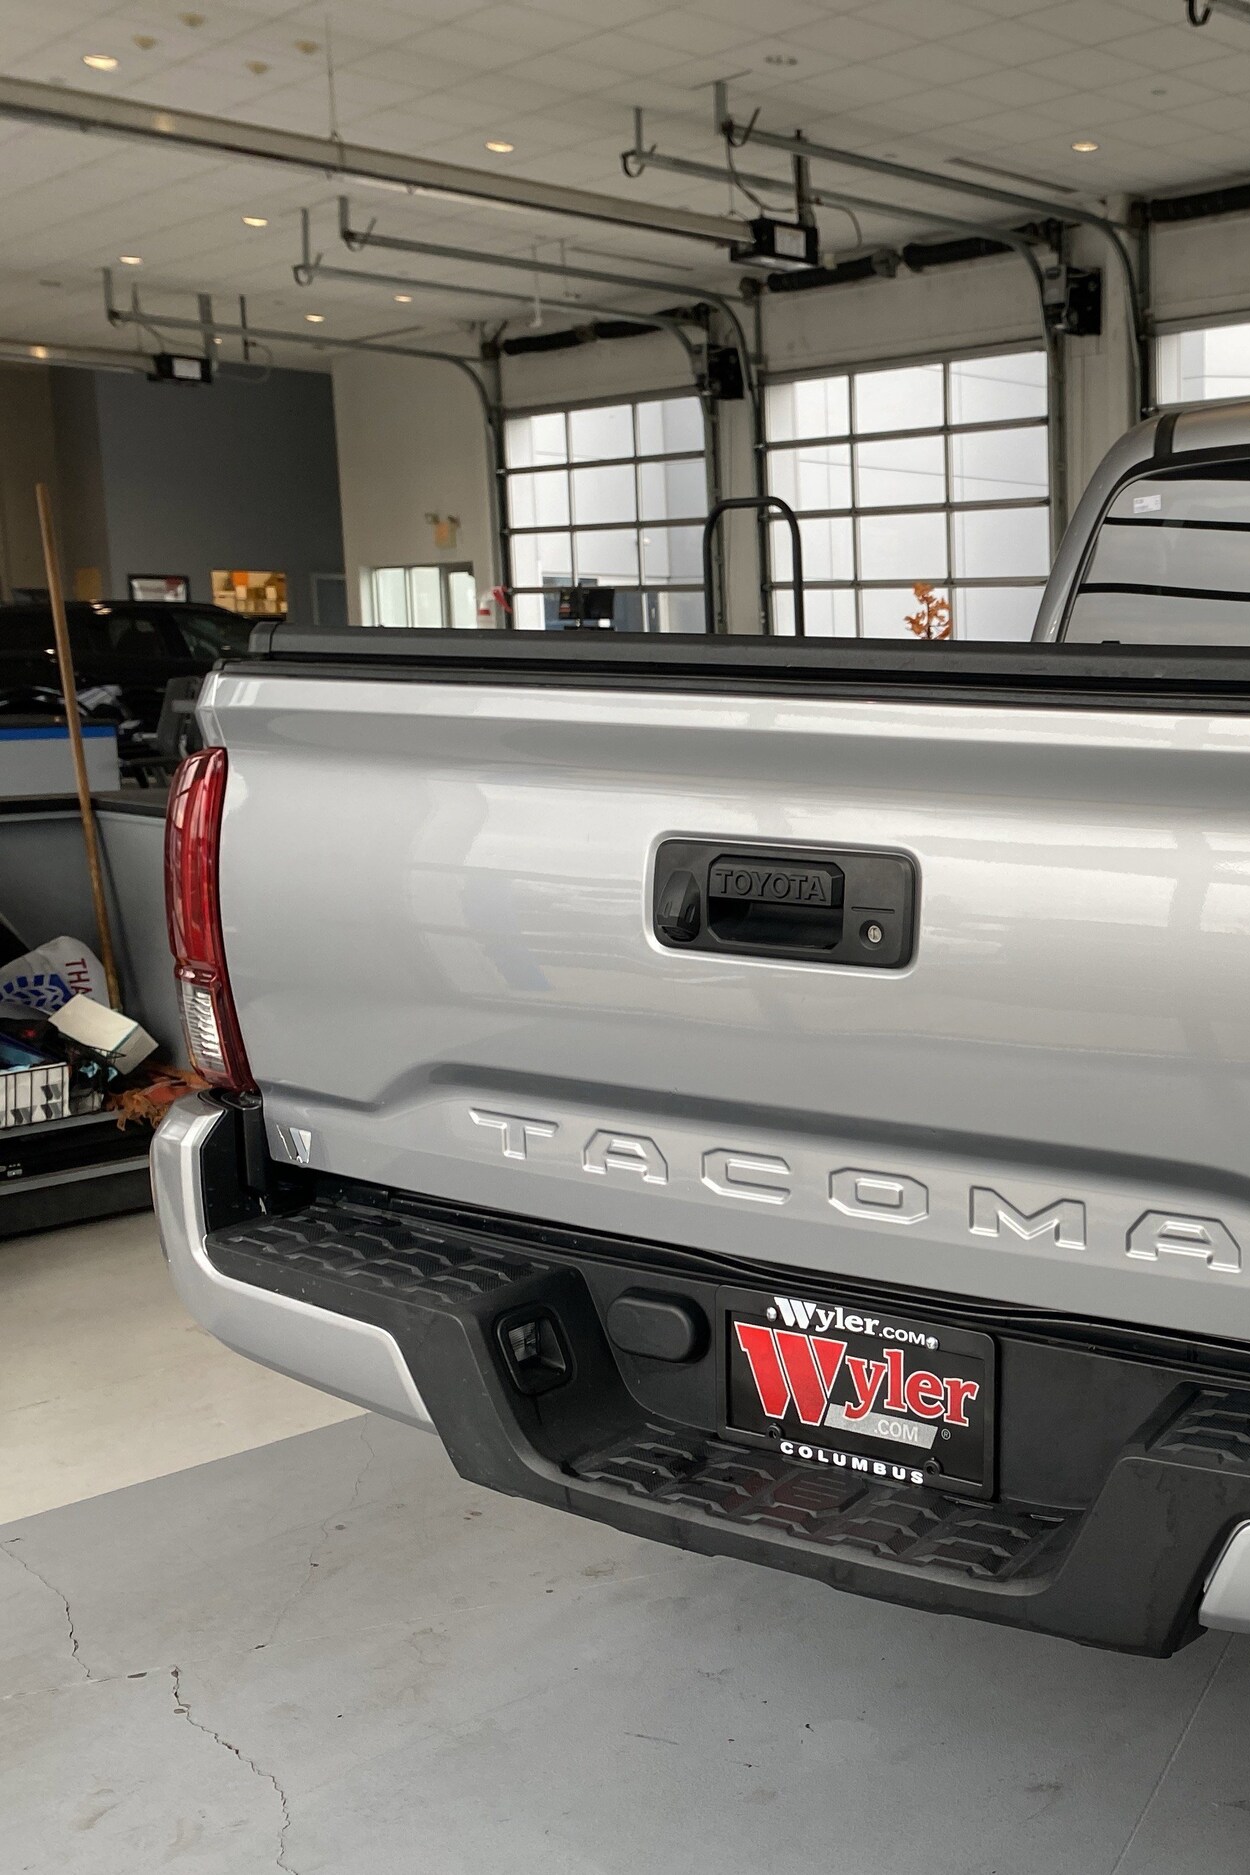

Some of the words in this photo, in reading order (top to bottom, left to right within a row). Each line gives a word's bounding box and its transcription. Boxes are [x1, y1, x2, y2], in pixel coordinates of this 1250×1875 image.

[715, 869, 827, 901] TOYOTA
[65, 958, 94, 1000] THA
[467, 1107, 1244, 1275] TACOMA
[734, 1321, 979, 1427] Wyler
[780, 1441, 924, 1485] COLUMBUS
